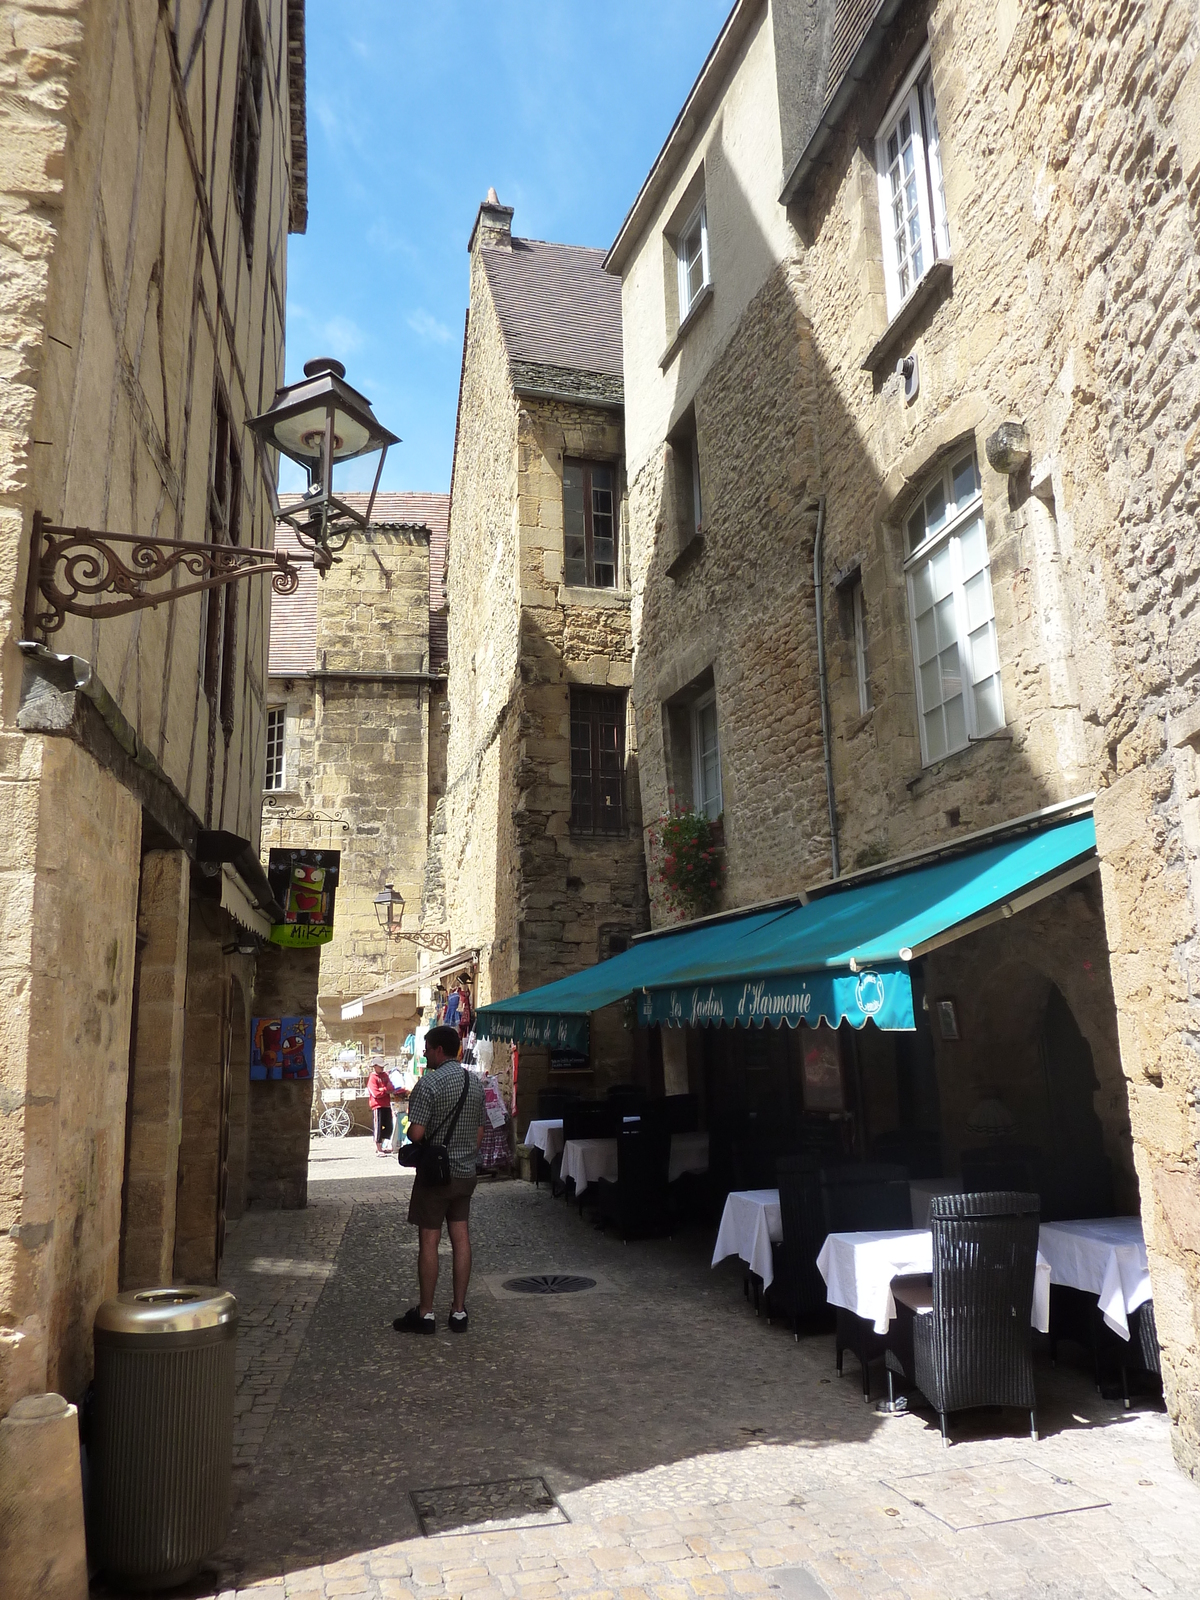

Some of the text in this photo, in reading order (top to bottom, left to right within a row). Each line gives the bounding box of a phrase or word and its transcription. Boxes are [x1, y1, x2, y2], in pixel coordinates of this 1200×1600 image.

[669, 980, 811, 1029] Les Jardins d'Harmonie
